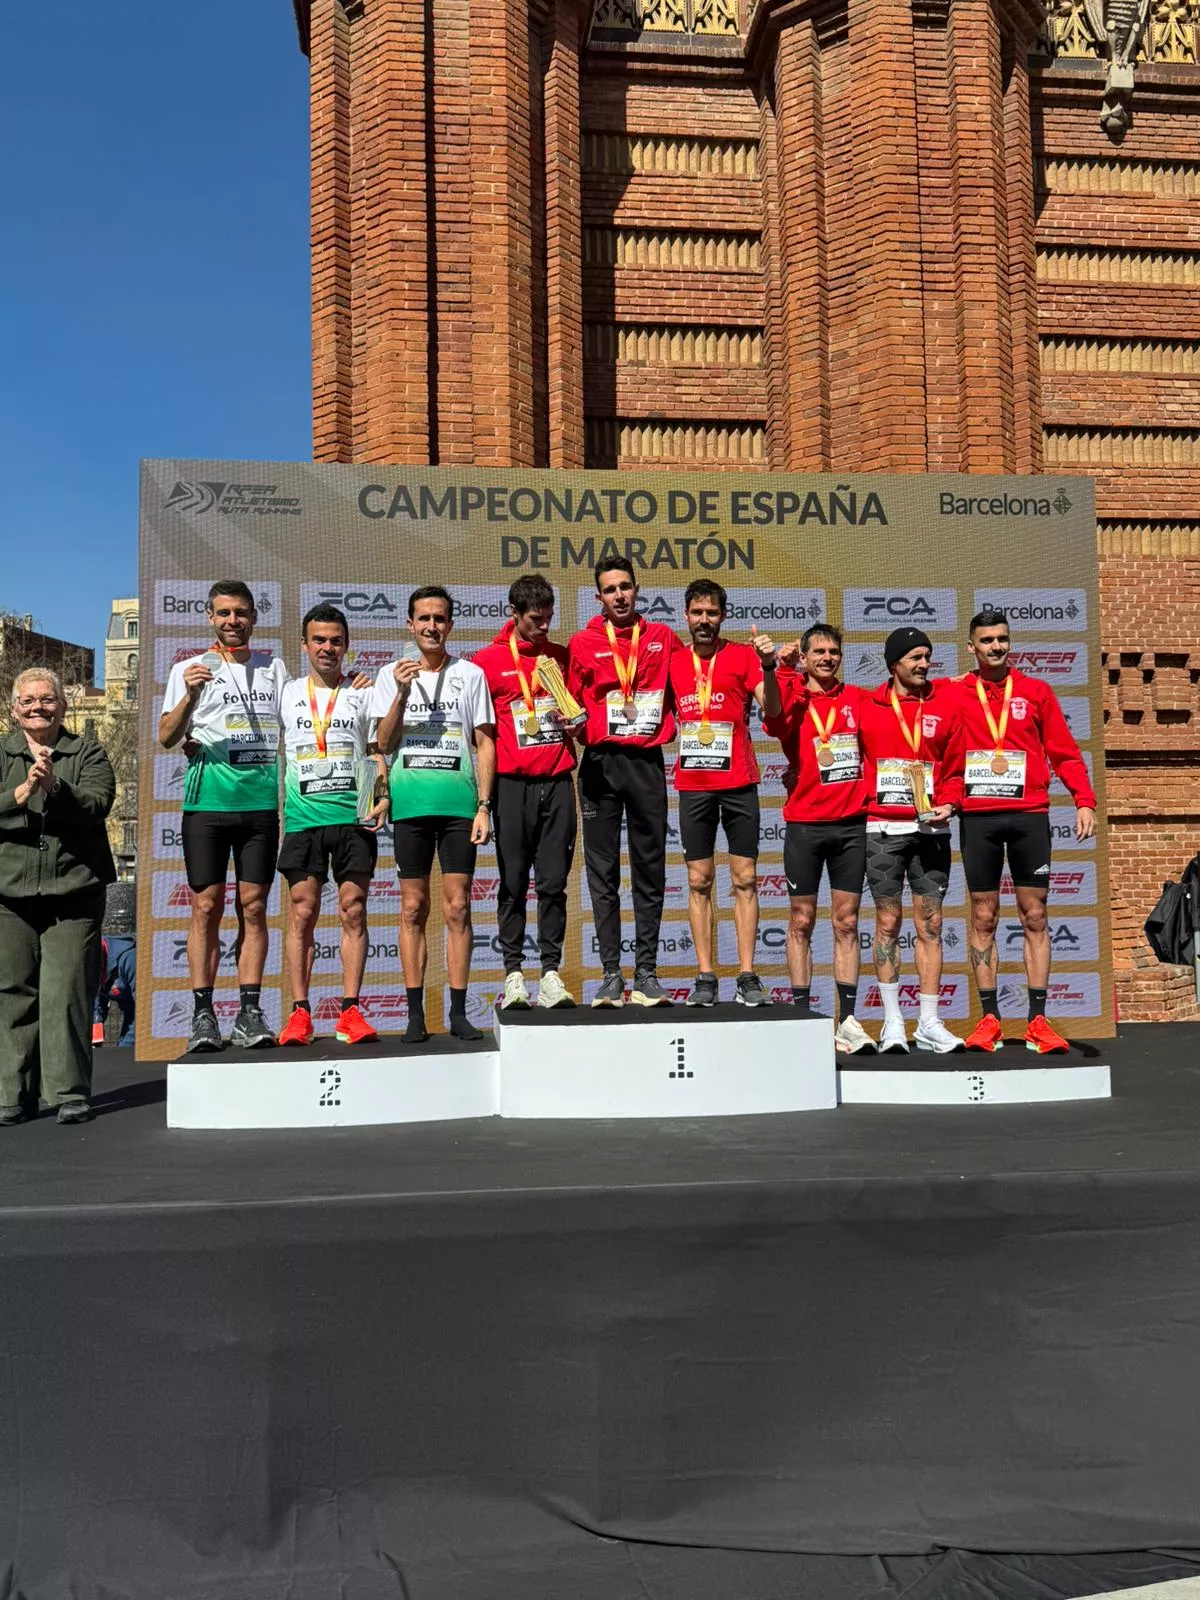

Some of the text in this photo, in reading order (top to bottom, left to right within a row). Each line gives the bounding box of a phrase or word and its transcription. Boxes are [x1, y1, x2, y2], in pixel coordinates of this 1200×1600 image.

[358, 484, 889, 526] CAMPEONATO DE ESPAÑA
[939, 492, 1051, 517] Barcelona
[501, 531, 755, 570] DE MARATÓN
[452, 600, 512, 618] Barcelo
[724, 602, 806, 620] Barcelona
[863, 597, 936, 616] FCA
[1019, 652, 1077, 667] RFEA
[223, 689, 275, 705] fondavi
[406, 739, 460, 751] BARCELONA 2026
[669, 1038, 694, 1079] 1
[320, 1070, 341, 1106] 2
[968, 1076, 985, 1101] 3
